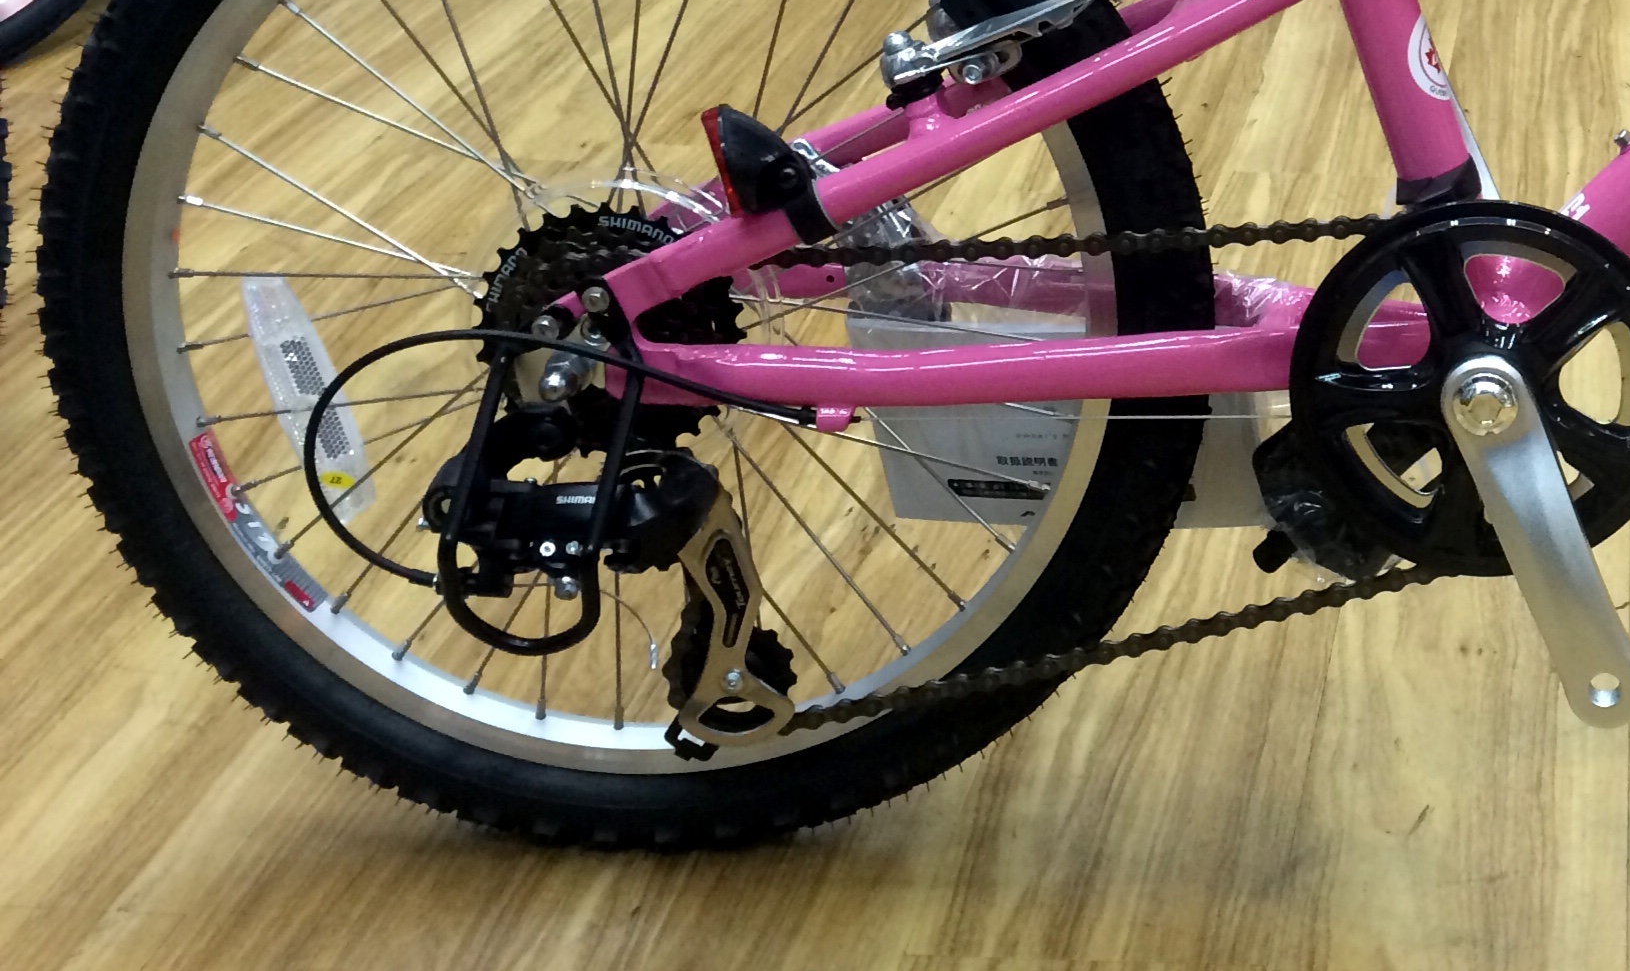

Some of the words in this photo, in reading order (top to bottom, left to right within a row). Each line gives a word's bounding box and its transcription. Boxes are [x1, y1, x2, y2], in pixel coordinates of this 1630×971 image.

[996, 455, 1059, 467] 取扱説明書
[556, 495, 596, 504] SHIMA
